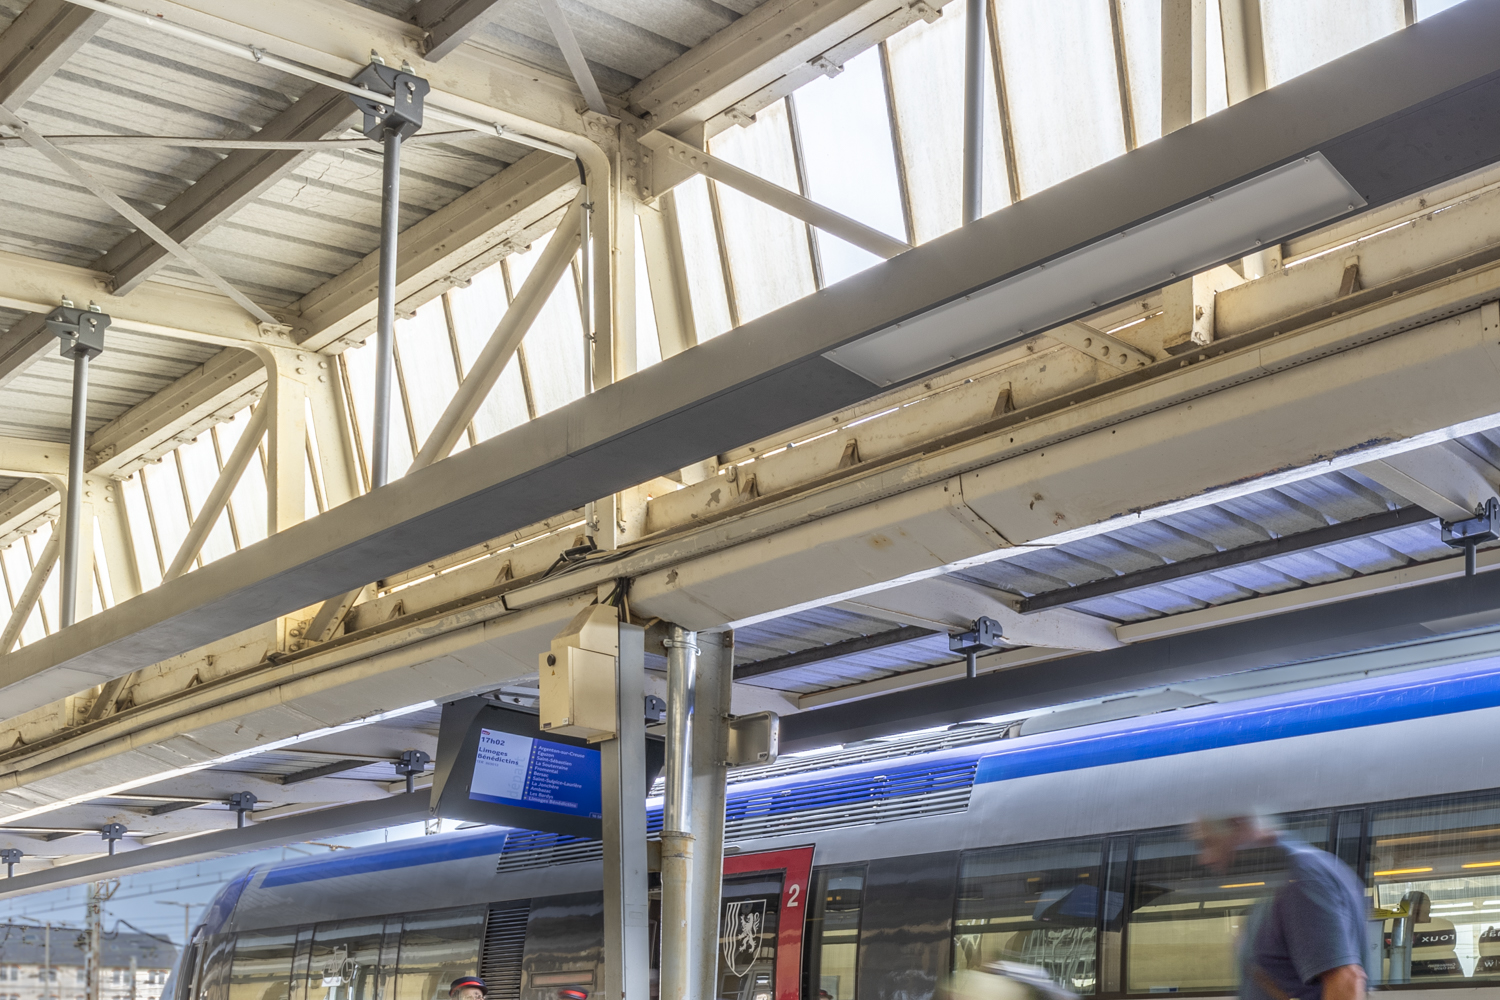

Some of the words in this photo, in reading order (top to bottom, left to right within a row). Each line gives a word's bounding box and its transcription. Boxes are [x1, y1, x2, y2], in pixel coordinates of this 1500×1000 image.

[481, 736, 505, 746] 17h02
[478, 746, 508, 757] Limoges
[477, 753, 519, 766] Bénédictins
[787, 884, 800, 907] 2
